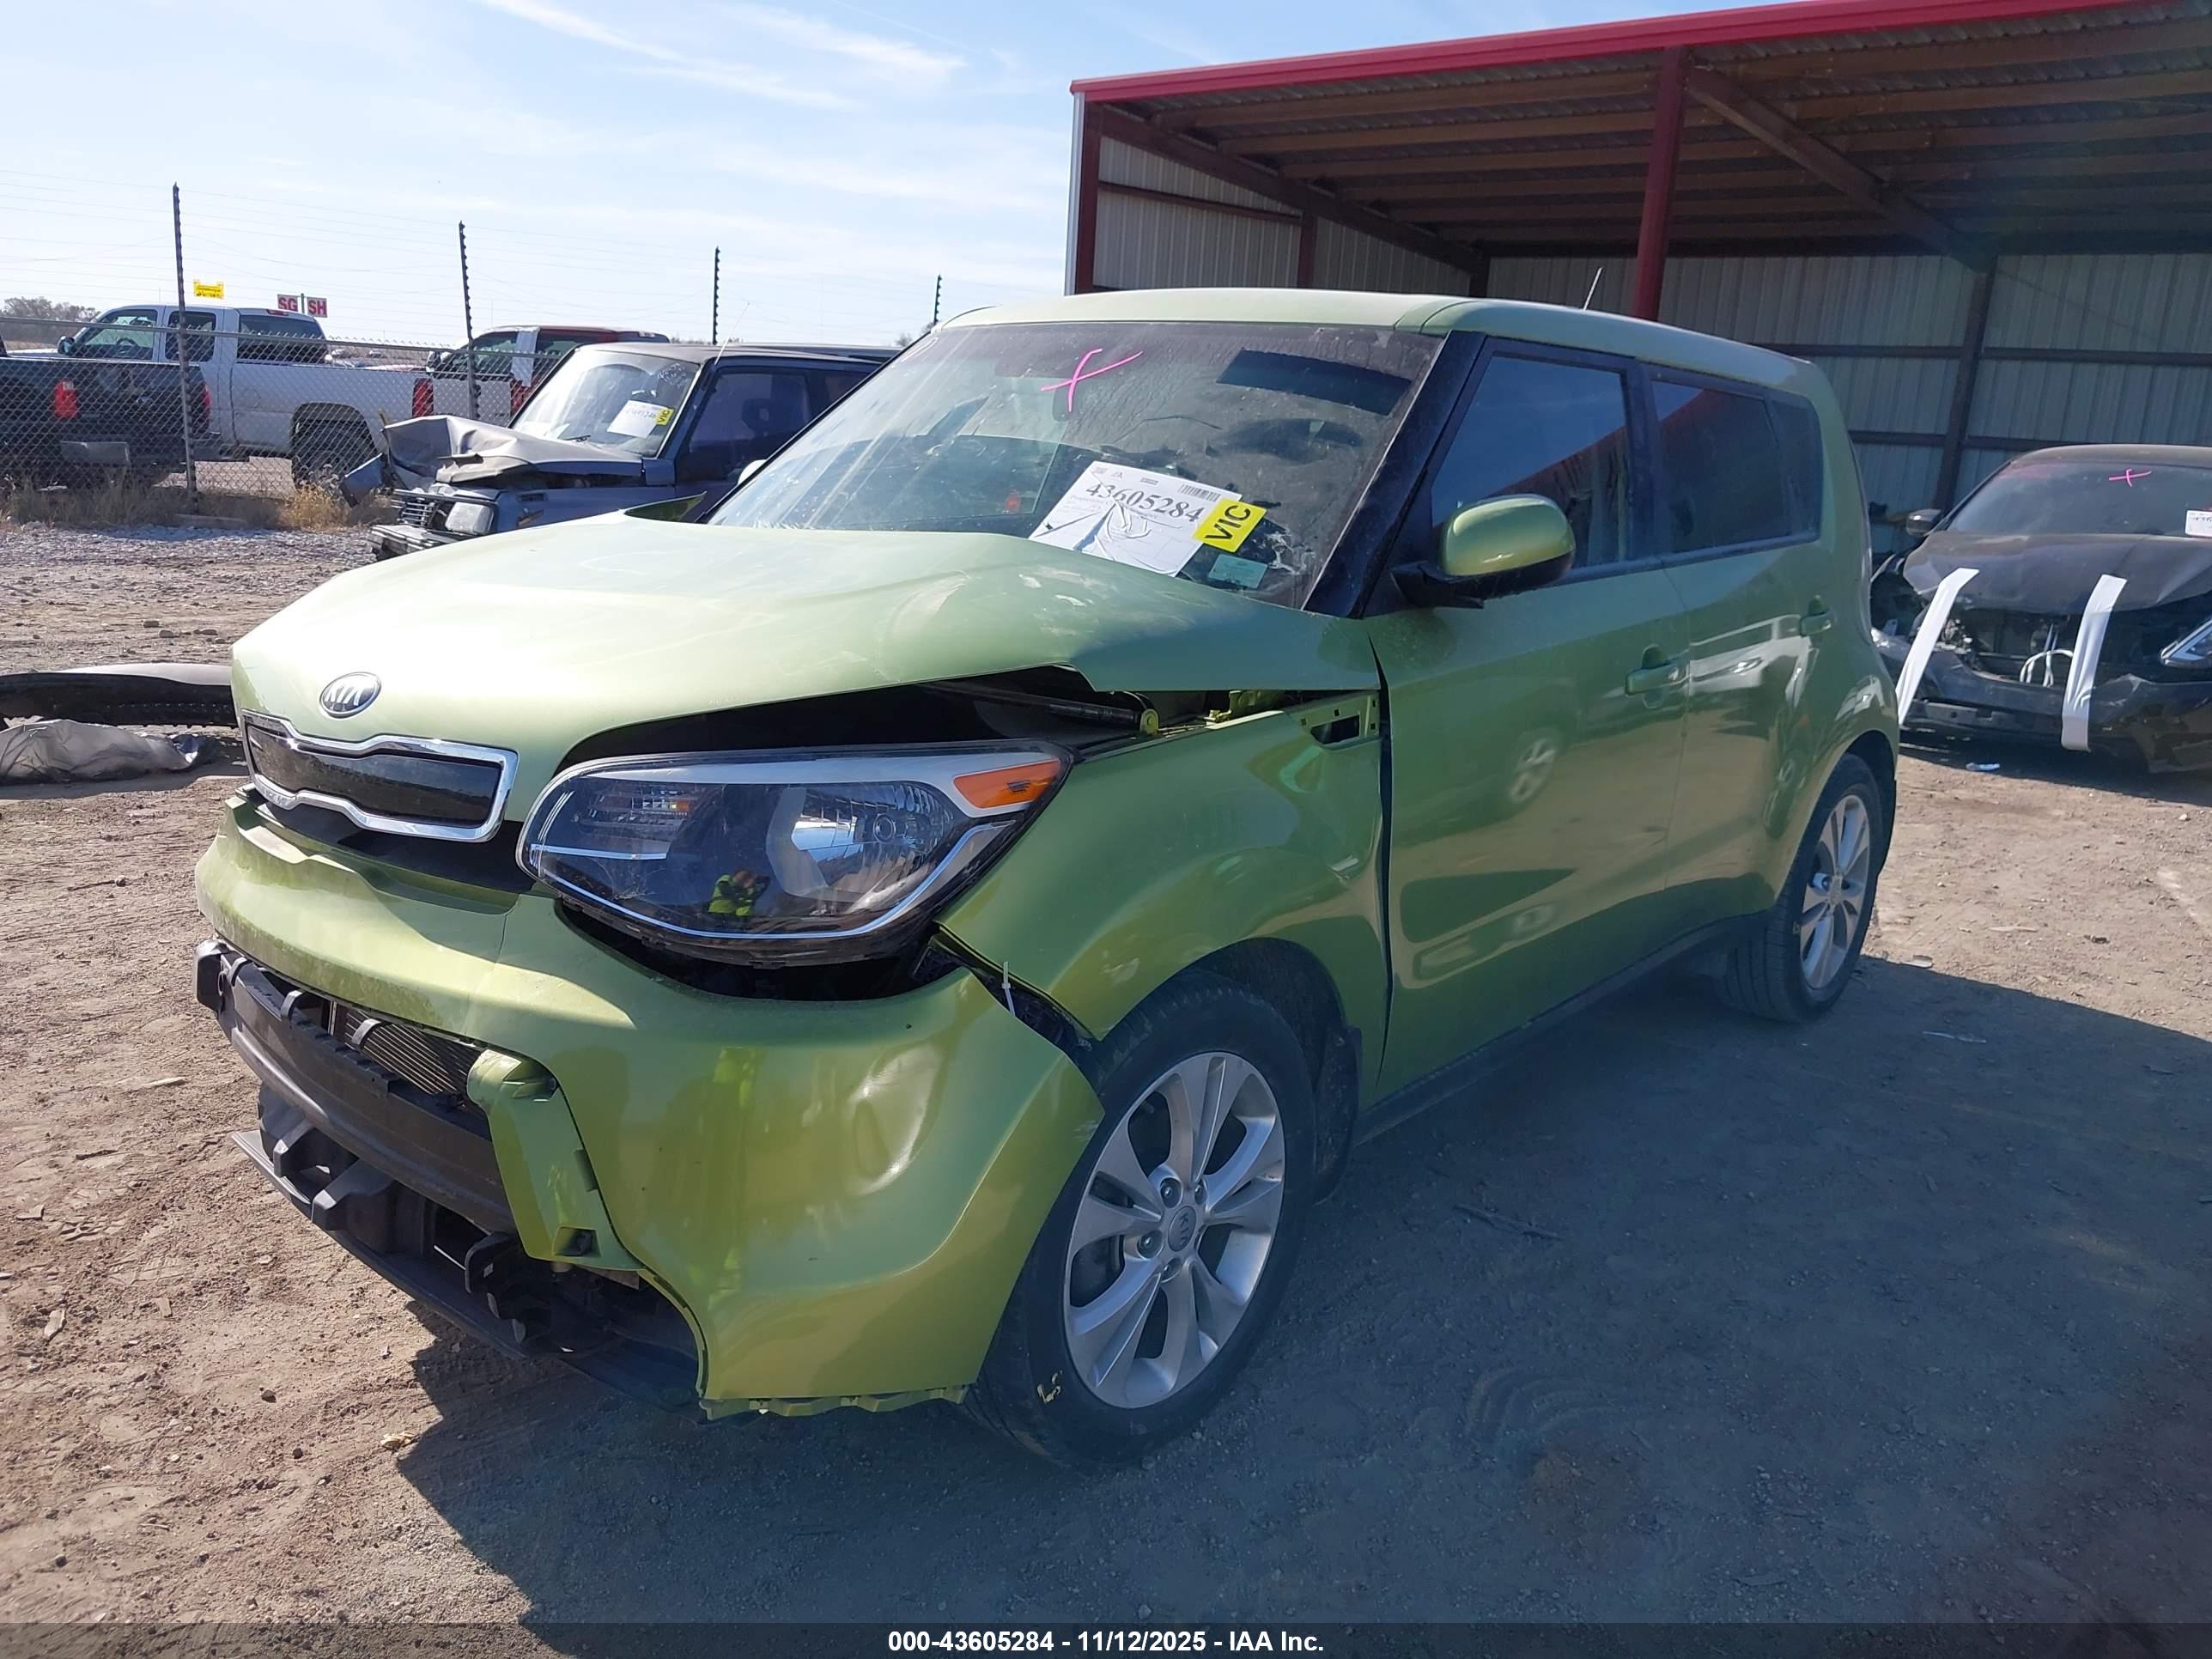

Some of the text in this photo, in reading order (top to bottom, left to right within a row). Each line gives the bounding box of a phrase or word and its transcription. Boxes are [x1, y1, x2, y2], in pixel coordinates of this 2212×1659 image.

[277, 296, 298, 312] SG
[307, 300, 327, 318] SH
[1085, 483, 1204, 523] 43605284
[1204, 505, 1252, 542] VIC
